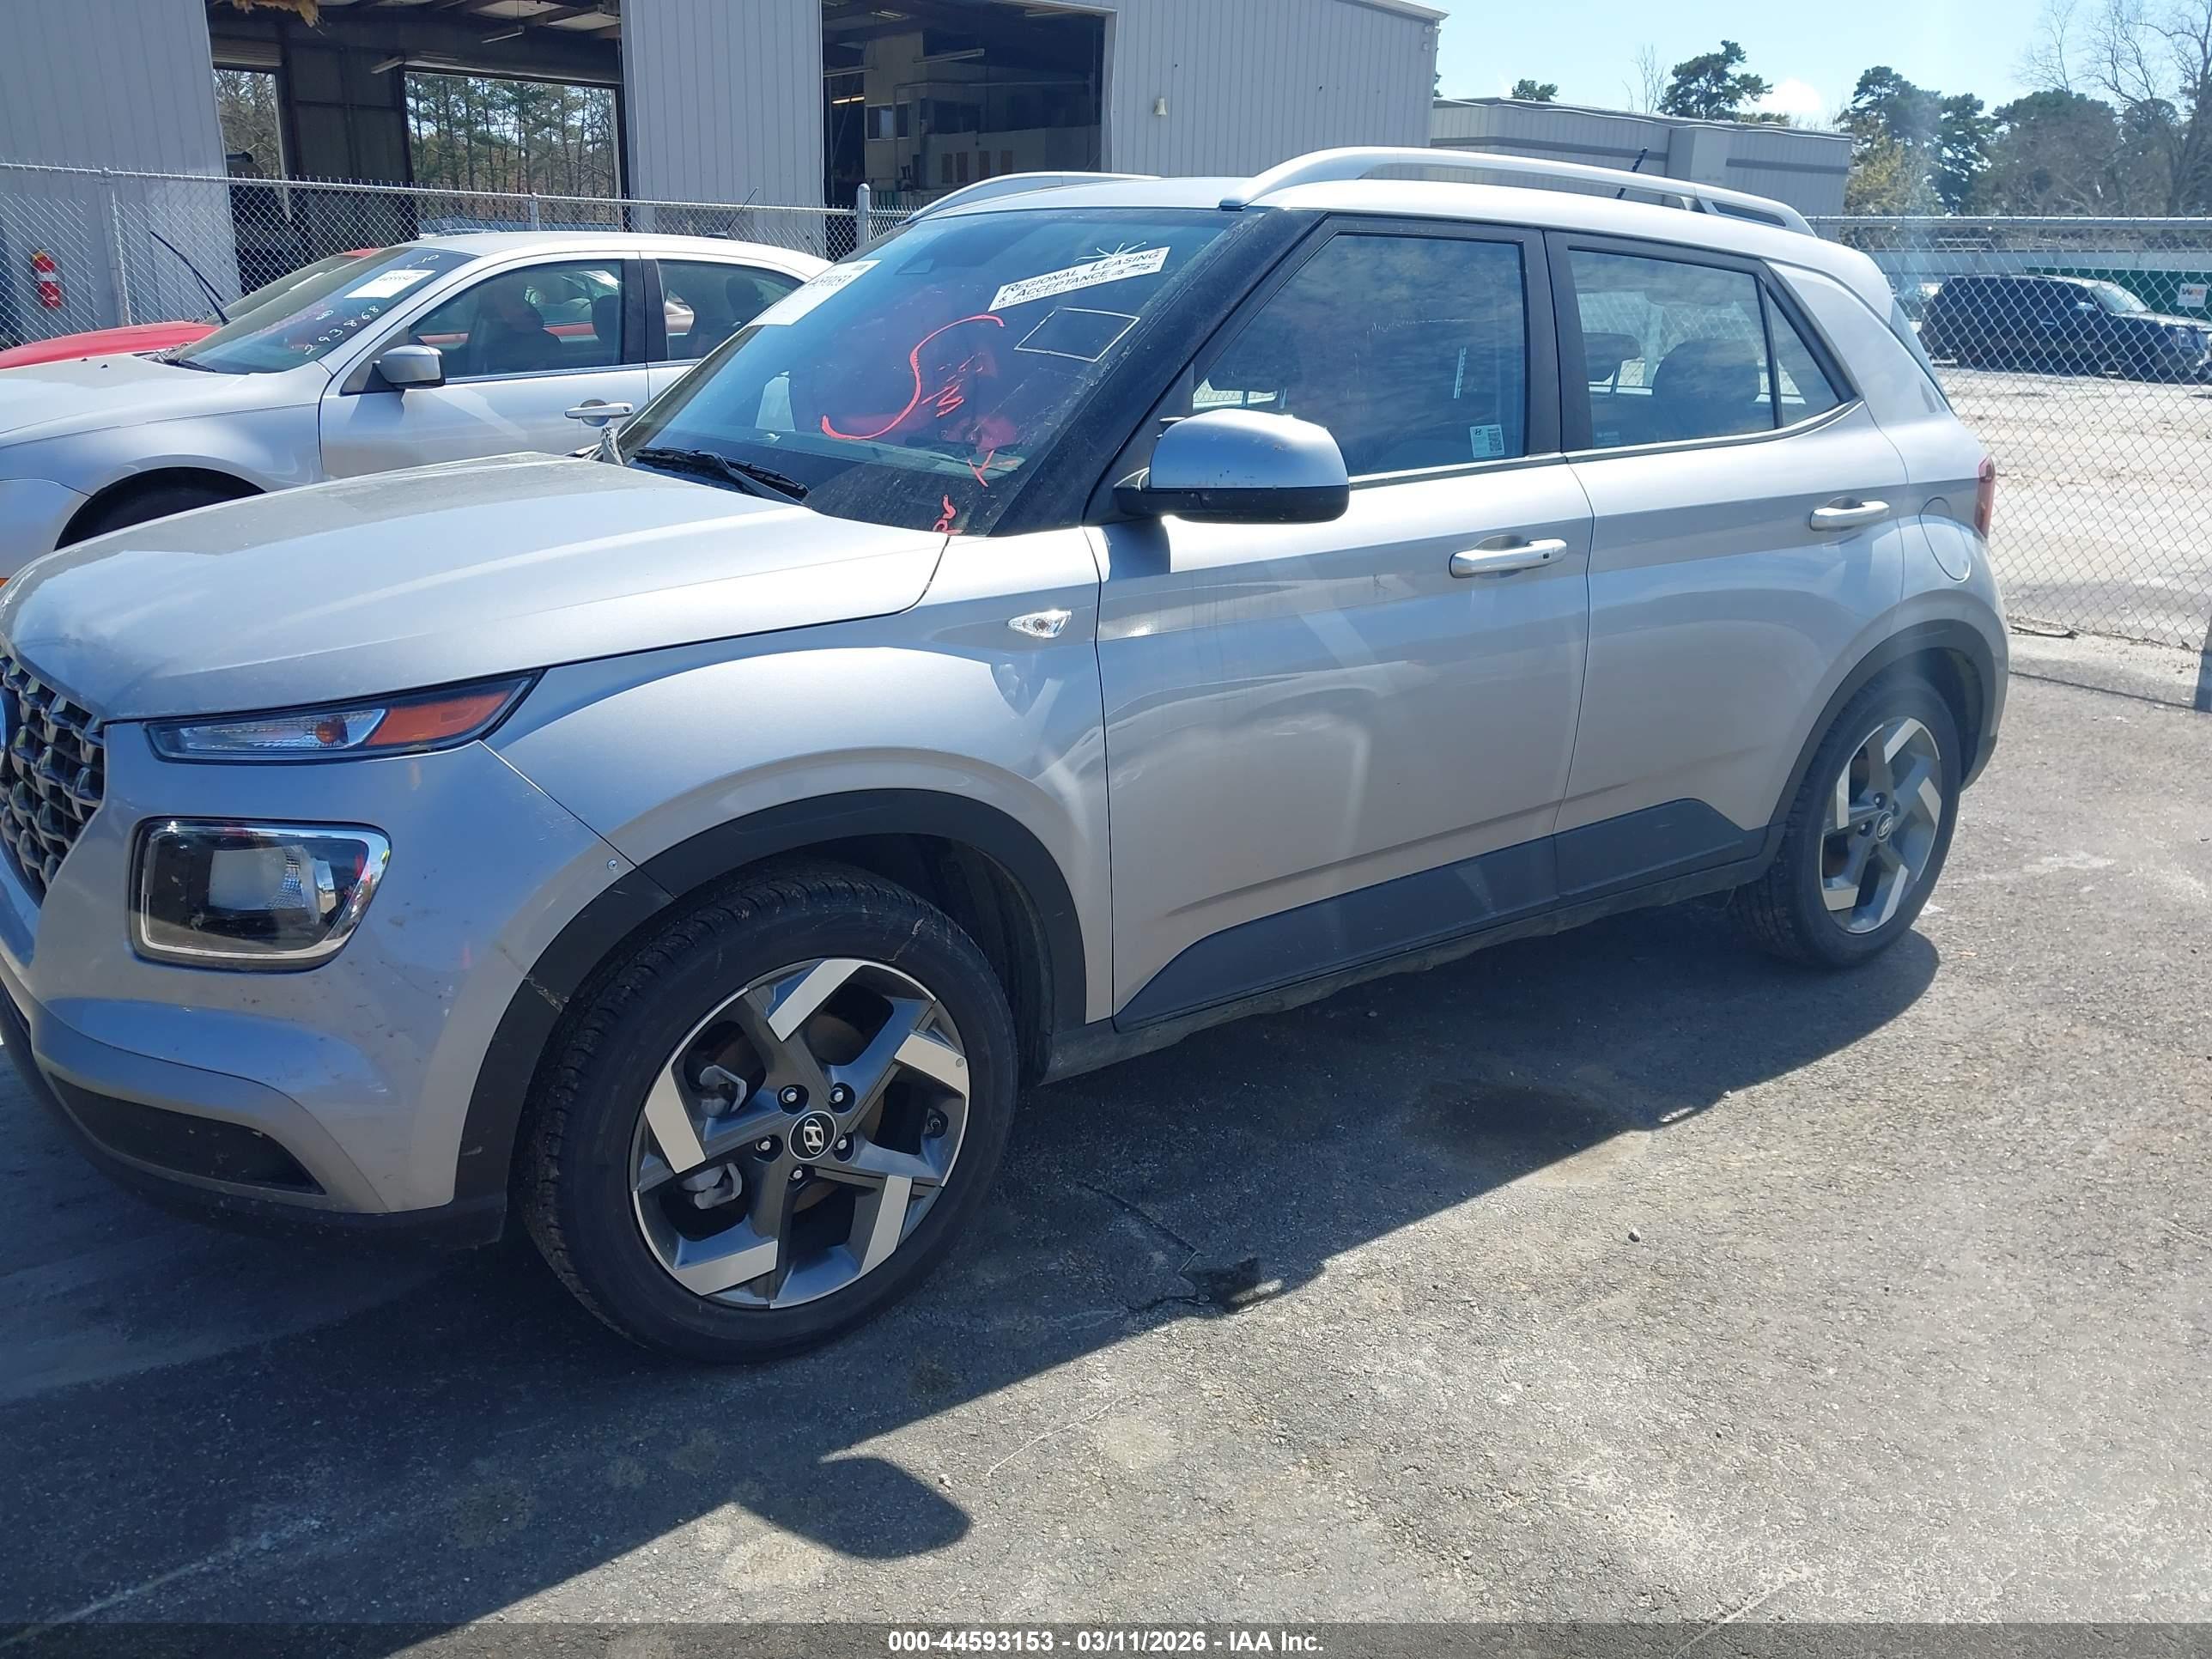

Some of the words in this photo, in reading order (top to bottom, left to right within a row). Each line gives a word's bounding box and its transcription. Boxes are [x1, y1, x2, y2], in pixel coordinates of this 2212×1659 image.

[998, 295, 1008, 304] &
[1013, 270, 1112, 300] ACCEPTANCE
[1003, 270, 1078, 295] REGIONAL
[1089, 252, 1160, 272] LEASING
[994, 286, 1066, 309] REMARKETING
